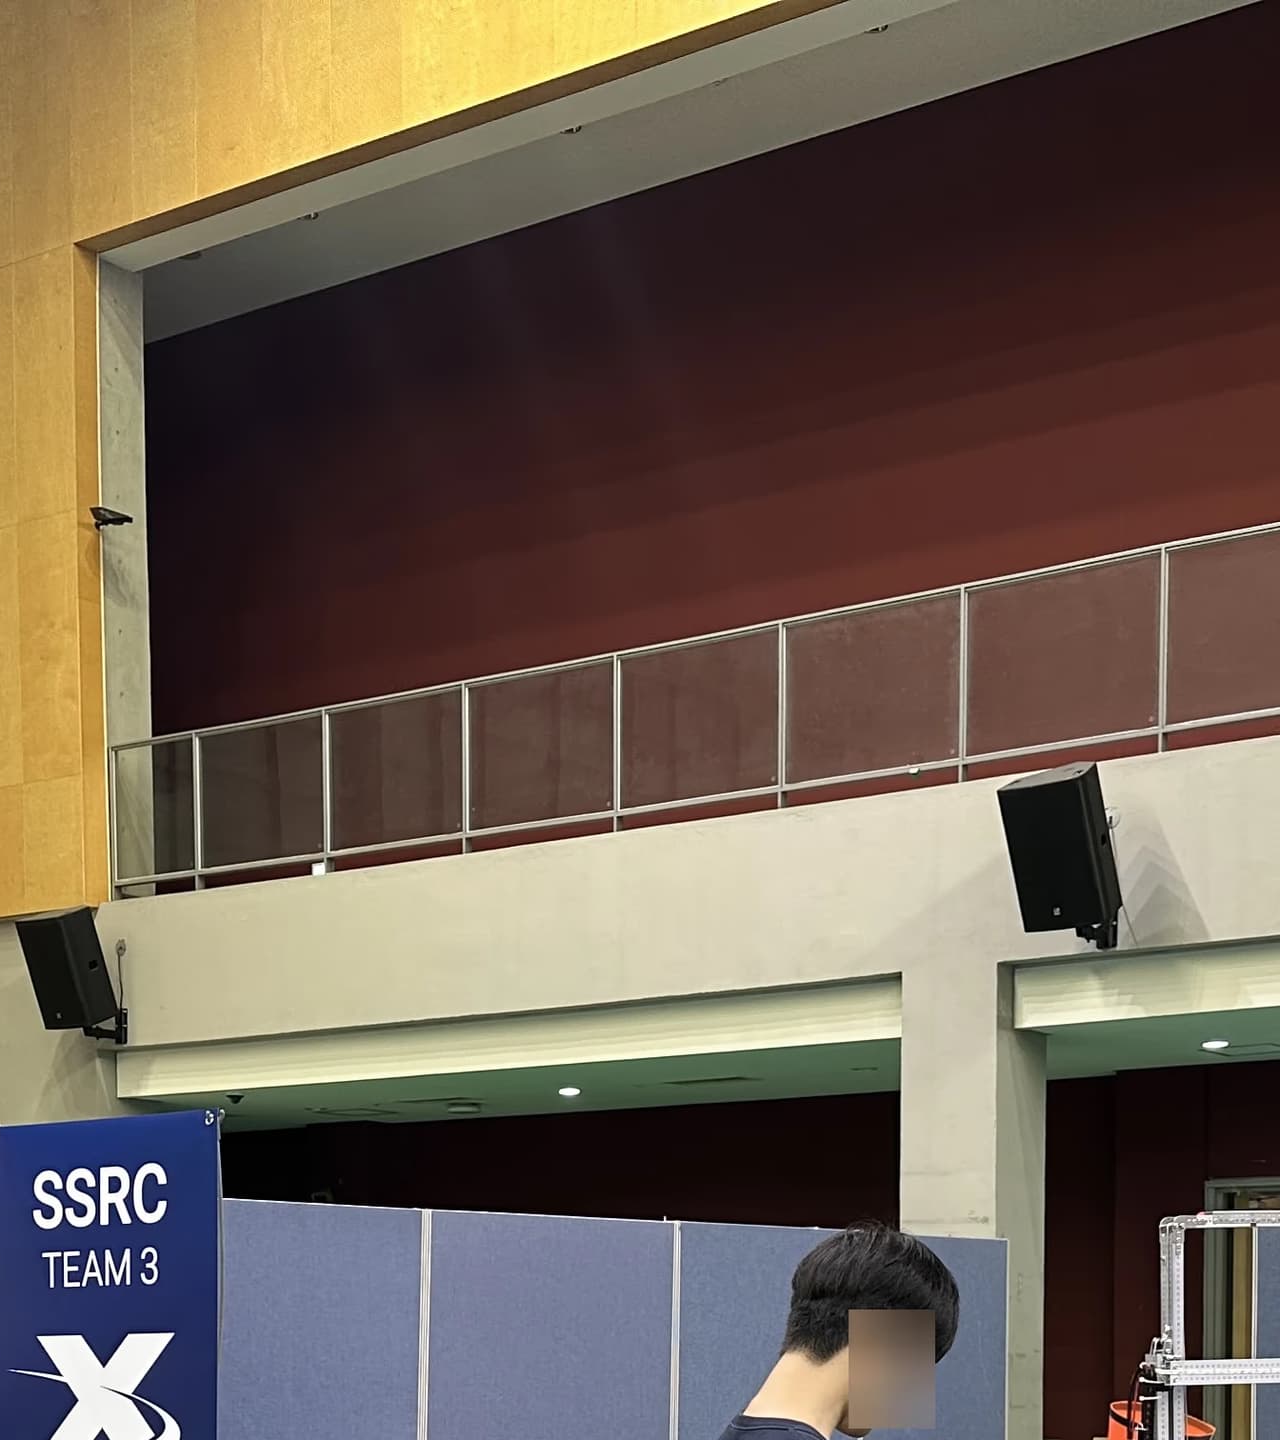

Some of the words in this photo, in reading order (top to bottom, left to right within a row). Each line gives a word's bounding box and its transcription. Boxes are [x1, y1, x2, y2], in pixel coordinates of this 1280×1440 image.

[32, 1162, 168, 1229] SSRC
[42, 1248, 131, 1288] TEAM
[140, 1246, 160, 1286] 3
